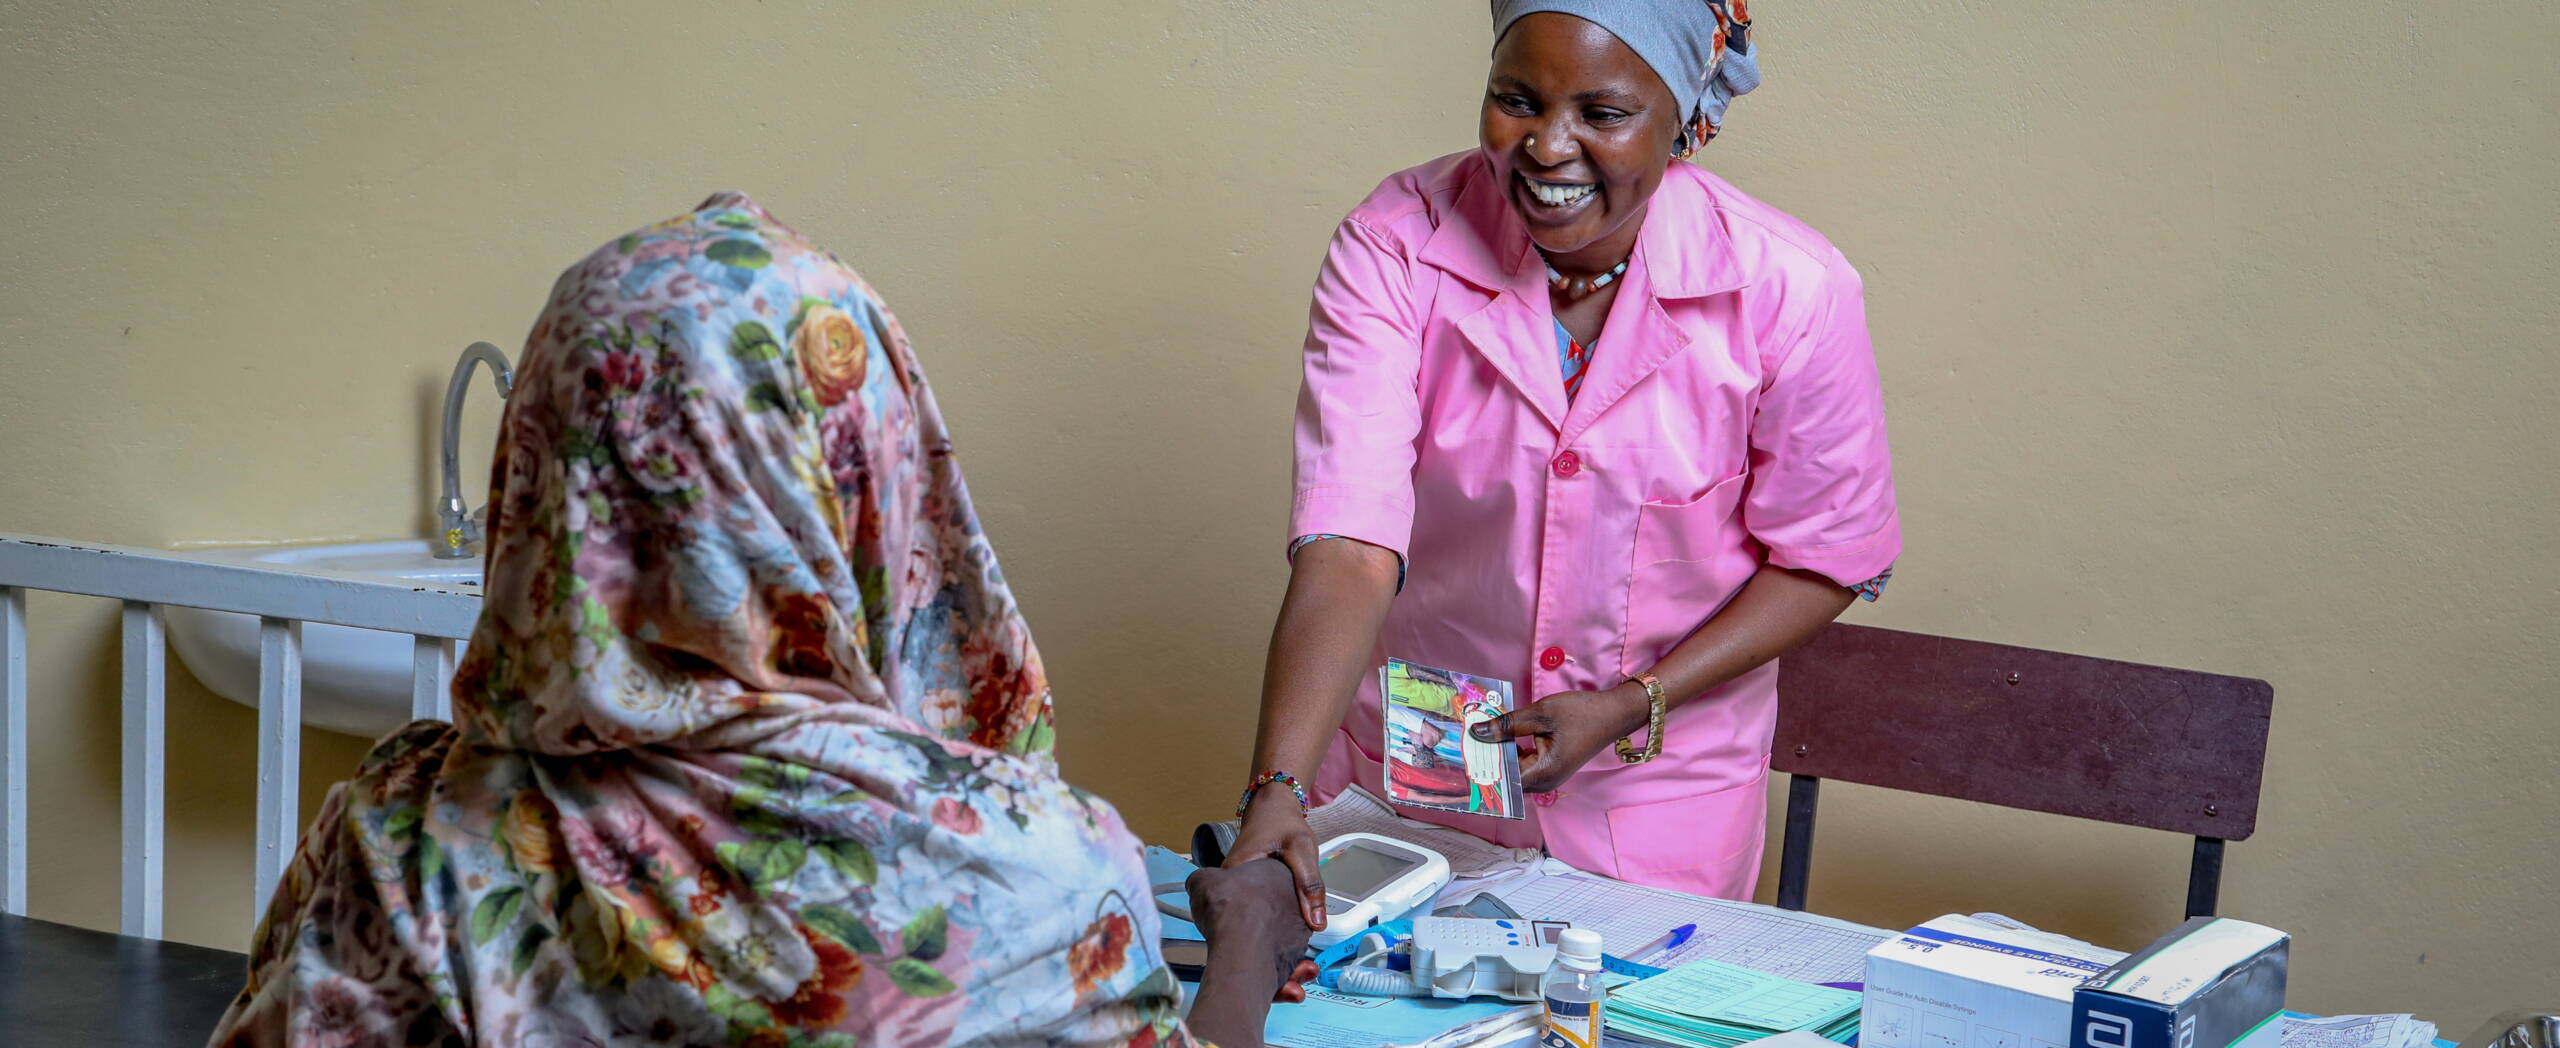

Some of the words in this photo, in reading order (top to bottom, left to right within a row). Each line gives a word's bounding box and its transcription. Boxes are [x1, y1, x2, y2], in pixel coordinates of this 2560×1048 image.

[1304, 989, 1369, 1006] REGIST
[1870, 984, 1885, 993] User
[1885, 987, 1904, 997] Guide
